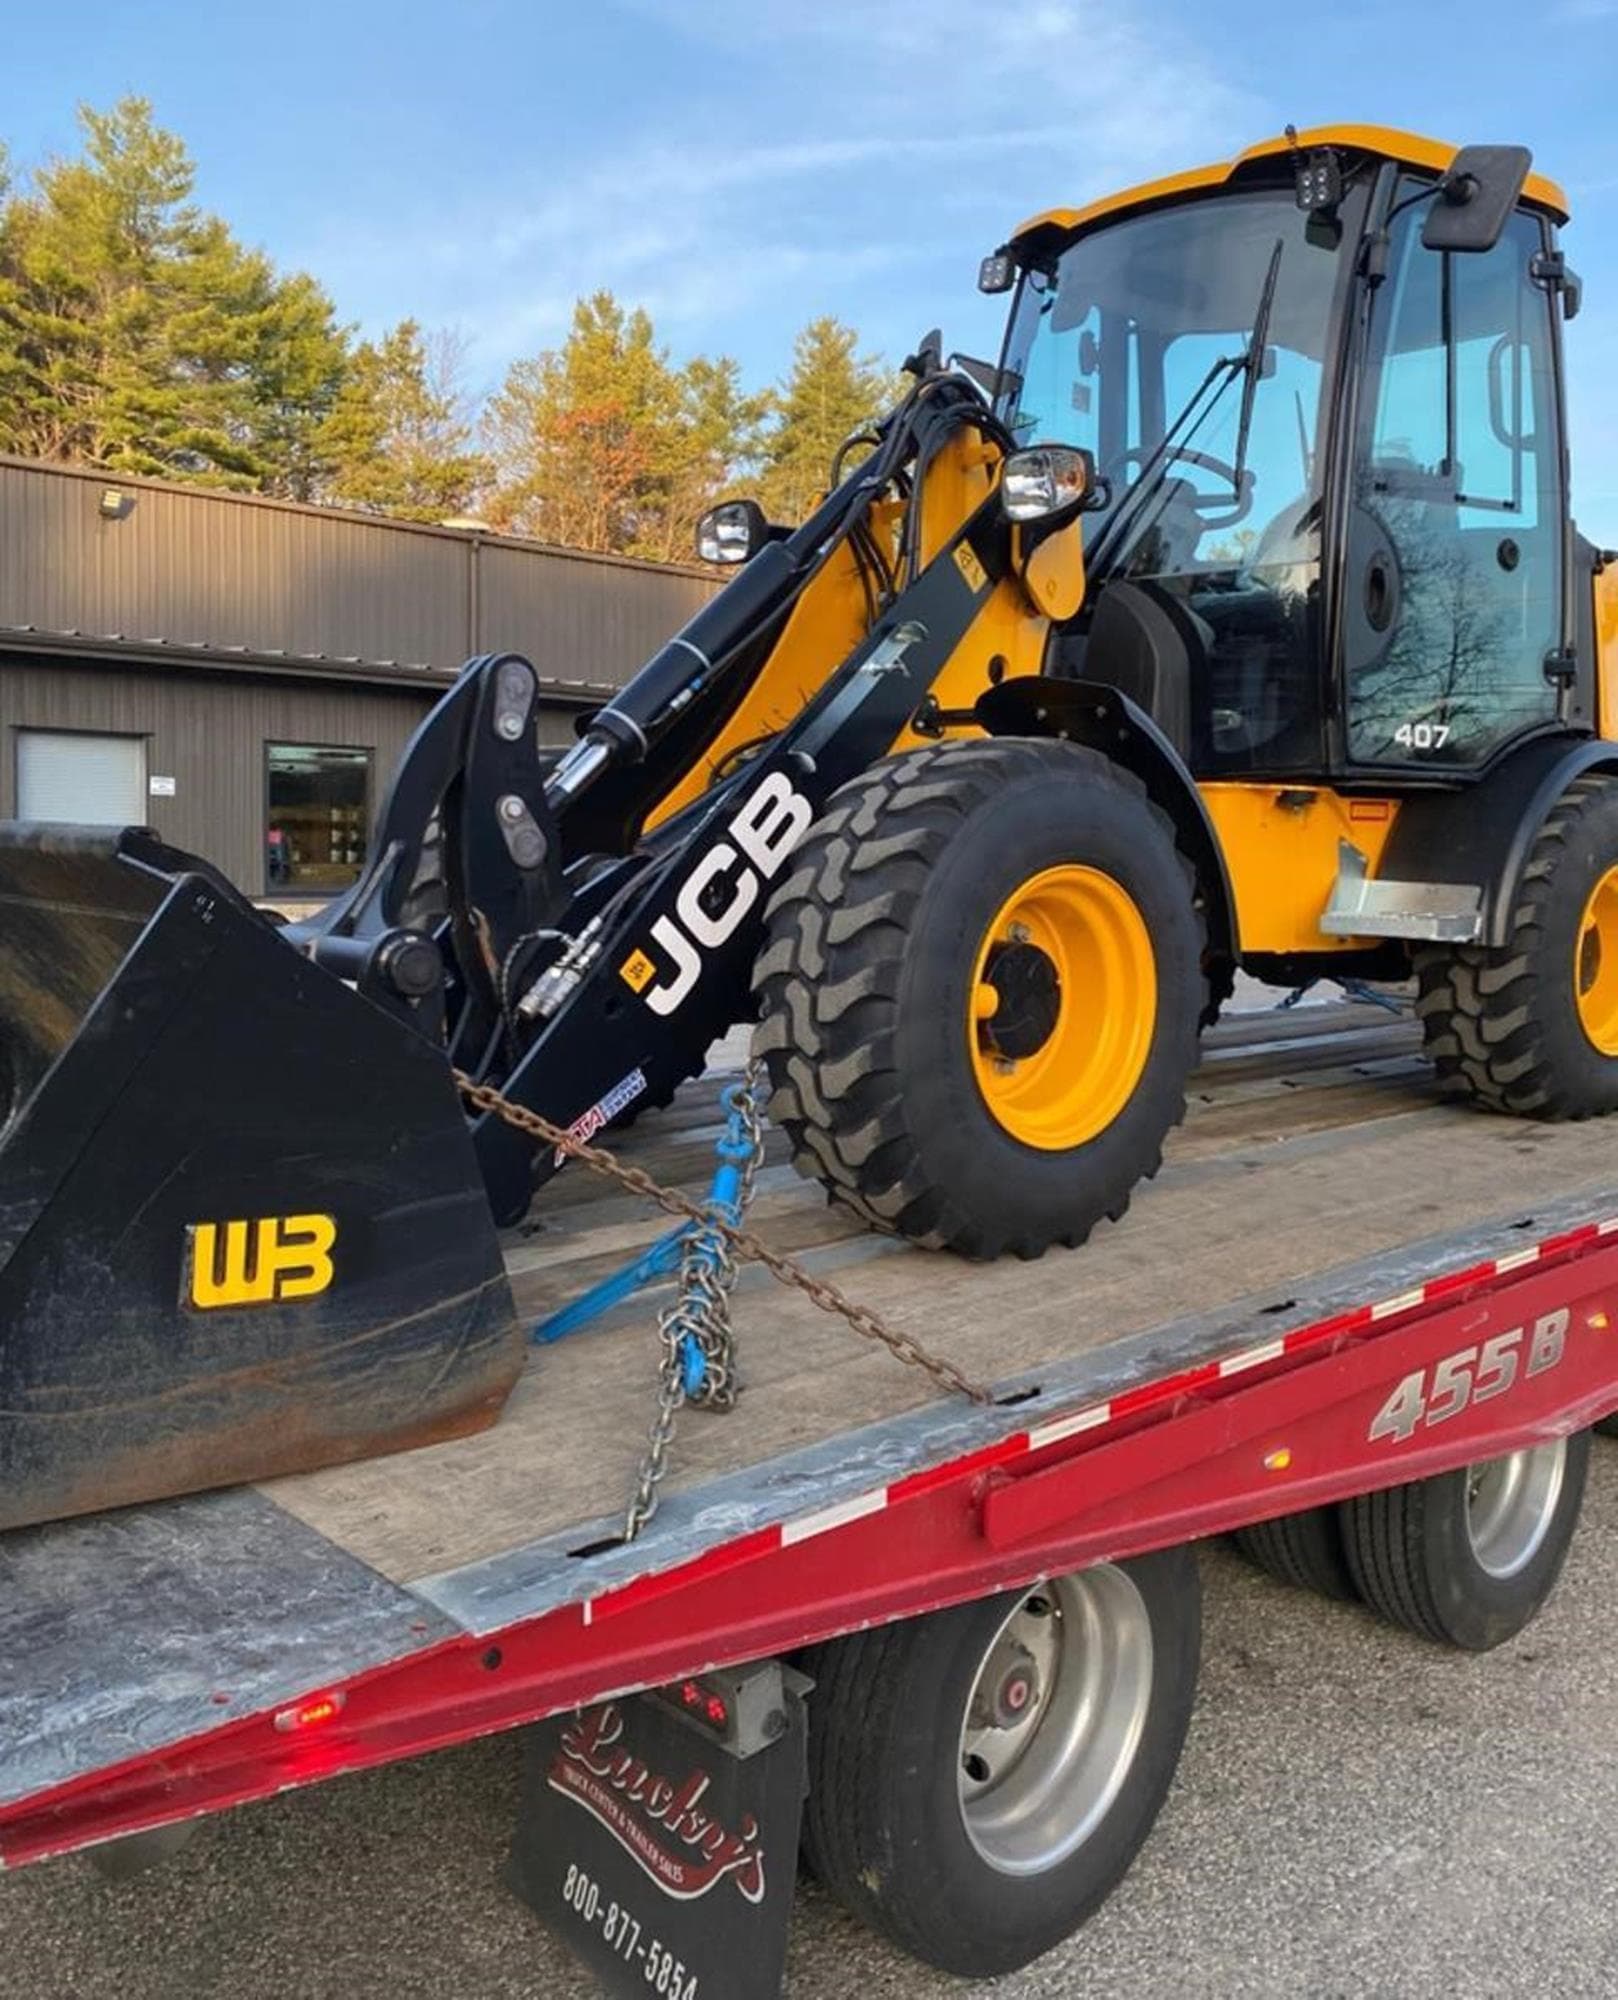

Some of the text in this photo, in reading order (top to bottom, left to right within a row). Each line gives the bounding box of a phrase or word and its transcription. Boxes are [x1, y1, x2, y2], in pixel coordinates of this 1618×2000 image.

[1394, 723, 1450, 749] 407
[645, 771, 813, 1016] JCB
[192, 1214, 336, 1308] WB
[563, 1863, 698, 2000] 800-877-5854
